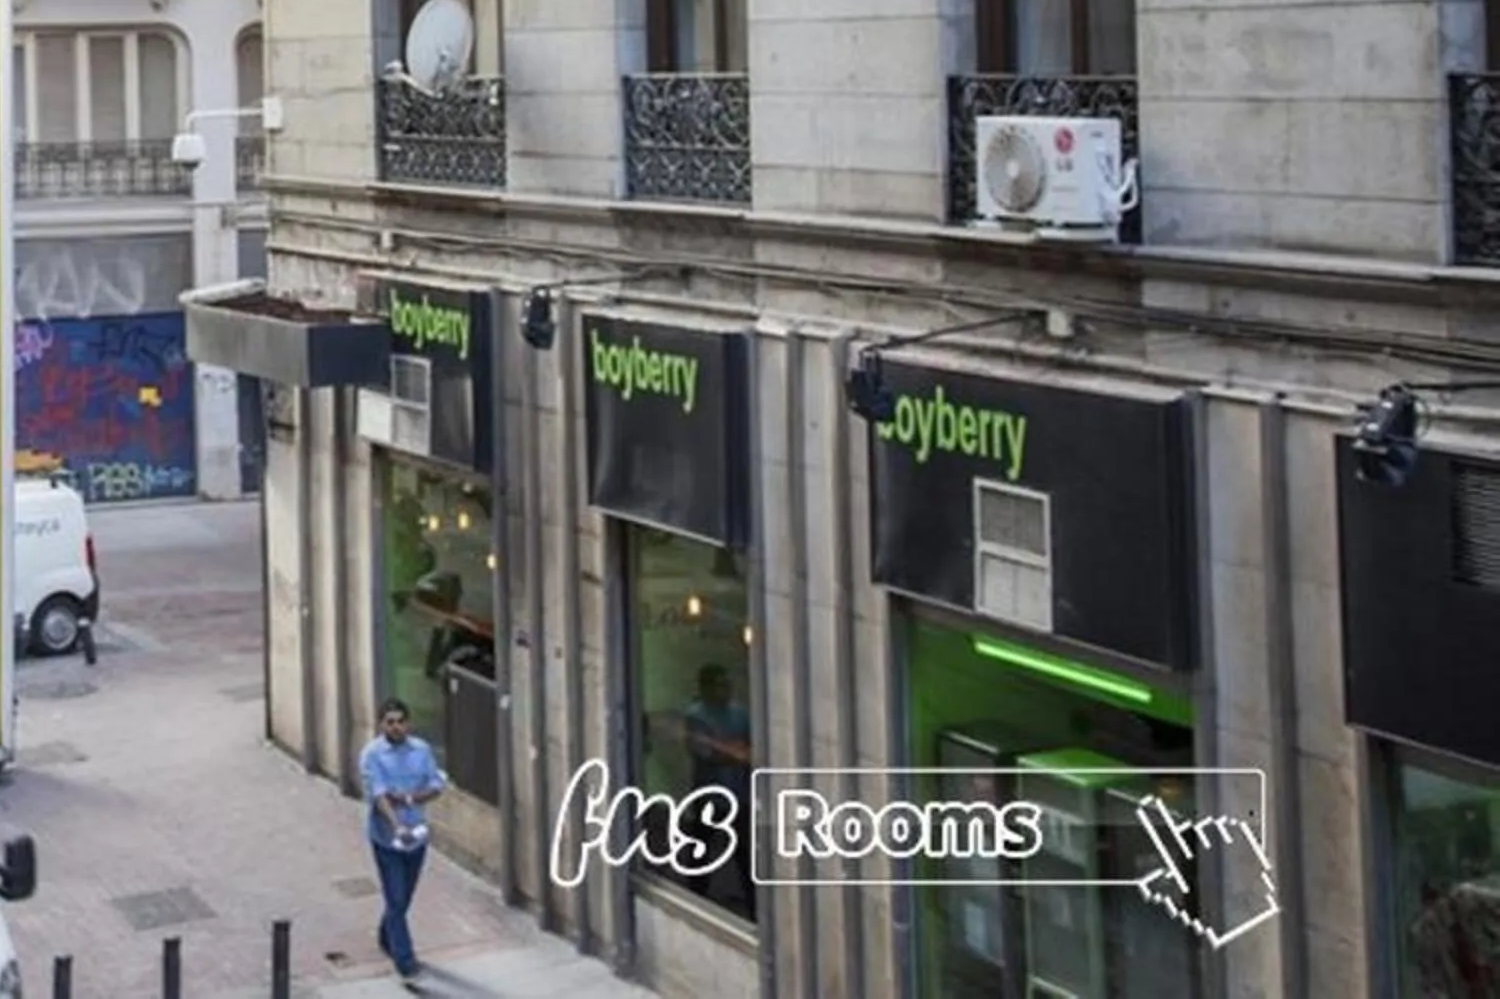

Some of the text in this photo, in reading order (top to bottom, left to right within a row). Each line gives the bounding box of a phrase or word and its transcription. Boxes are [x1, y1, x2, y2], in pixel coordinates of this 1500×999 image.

[389, 288, 470, 361] boyberry
[590, 327, 698, 414] boyberry
[875, 384, 1027, 481] oyberry
